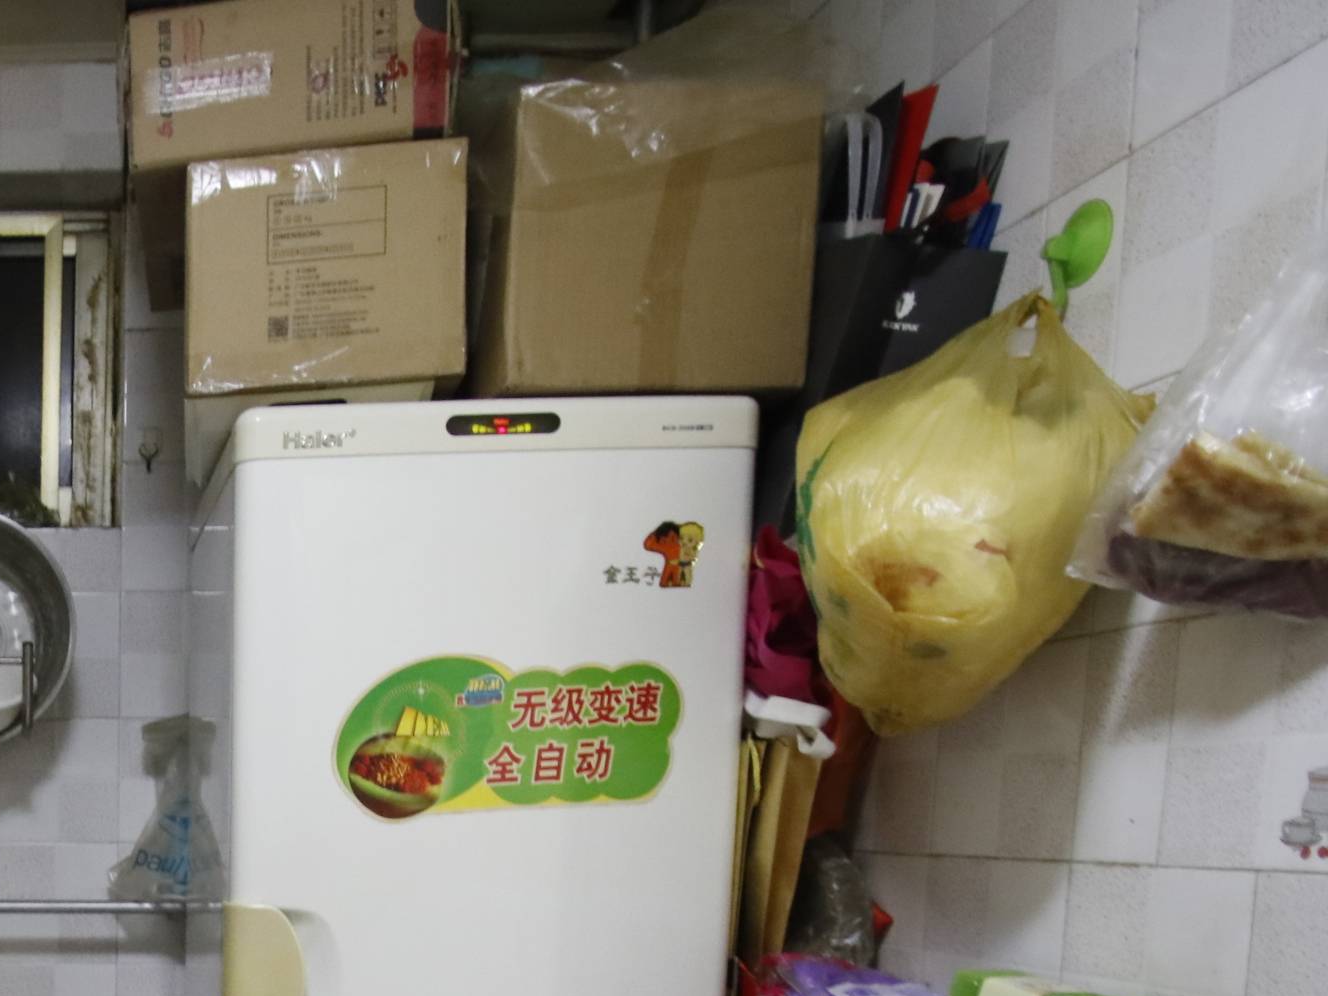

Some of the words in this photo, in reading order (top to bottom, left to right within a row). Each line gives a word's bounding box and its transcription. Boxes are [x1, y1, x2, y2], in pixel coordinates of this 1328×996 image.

[283, 430, 347, 450] Haier
[603, 565, 661, 587] 金王子
[510, 682, 661, 730] 无级变速
[486, 738, 613, 784] 全自动
